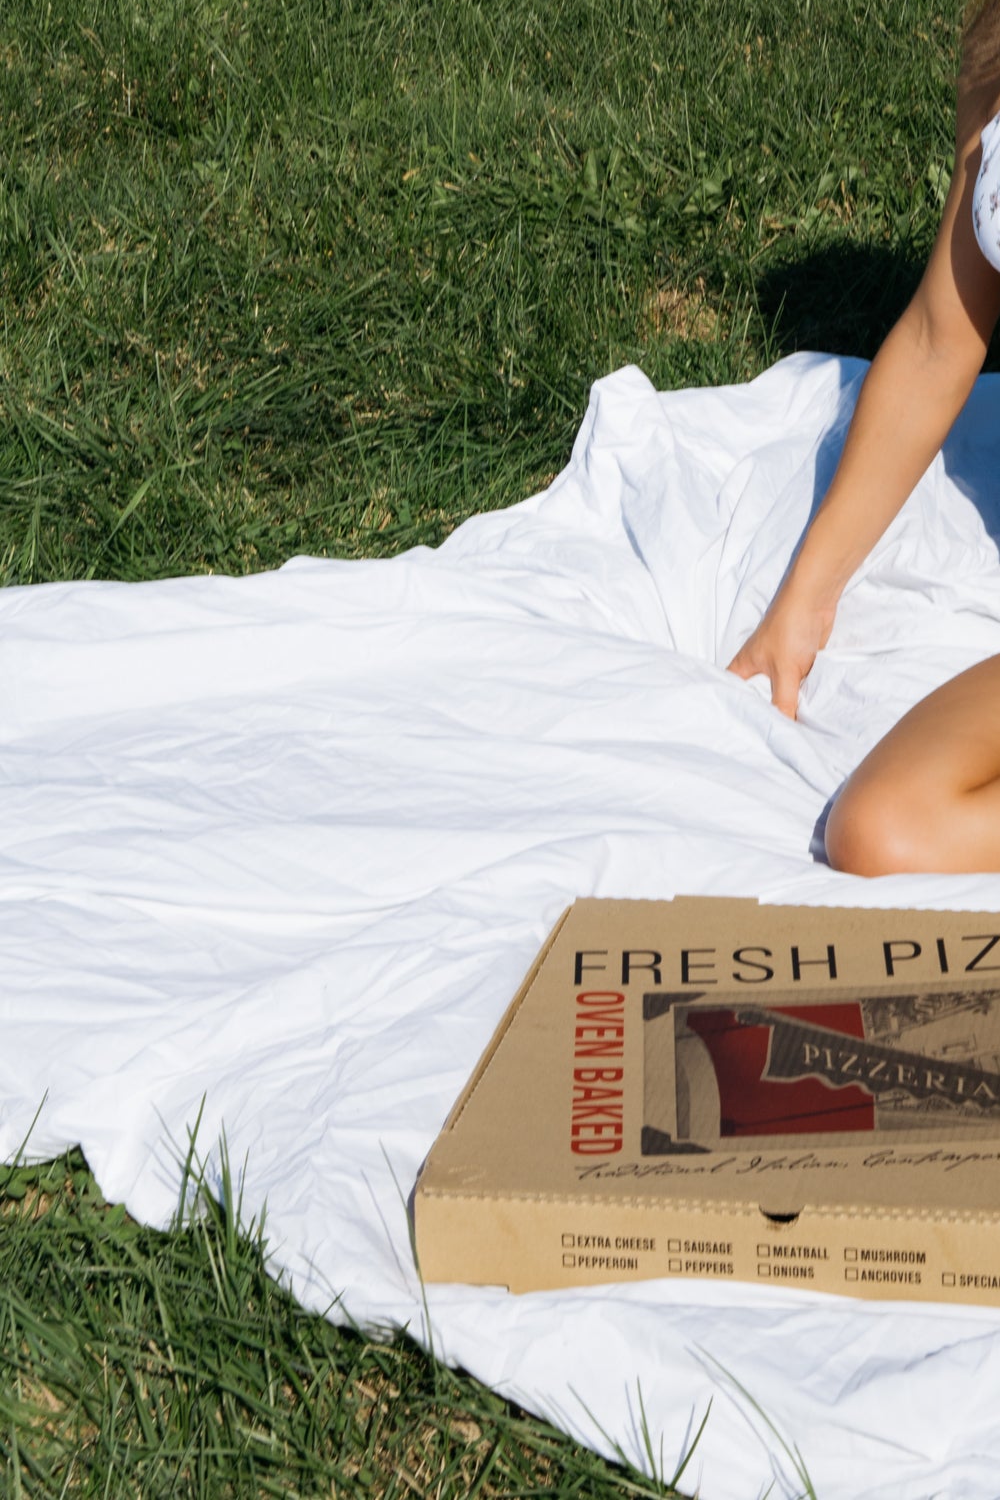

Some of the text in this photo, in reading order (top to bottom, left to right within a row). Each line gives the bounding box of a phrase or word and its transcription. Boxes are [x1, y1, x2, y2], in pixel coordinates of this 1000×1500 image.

[573, 944, 838, 986] FRESH
[571, 991, 625, 1155] OVEN BAKED
[802, 1043, 997, 1100] PIZZERIA
[574, 1157, 736, 1180] Traditional
[577, 1236, 656, 1251] EXTRA CHEESE
[684, 1240, 733, 1255] SAUSAGE
[773, 1245, 829, 1260] MEATBALL
[861, 1249, 926, 1264] MUSHROOM
[578, 1255, 639, 1270] PEPPERONI
[685, 1260, 734, 1275] PEPPERS
[773, 1265, 815, 1279] ONIONS
[861, 1269, 922, 1284] ANCHOVIES
